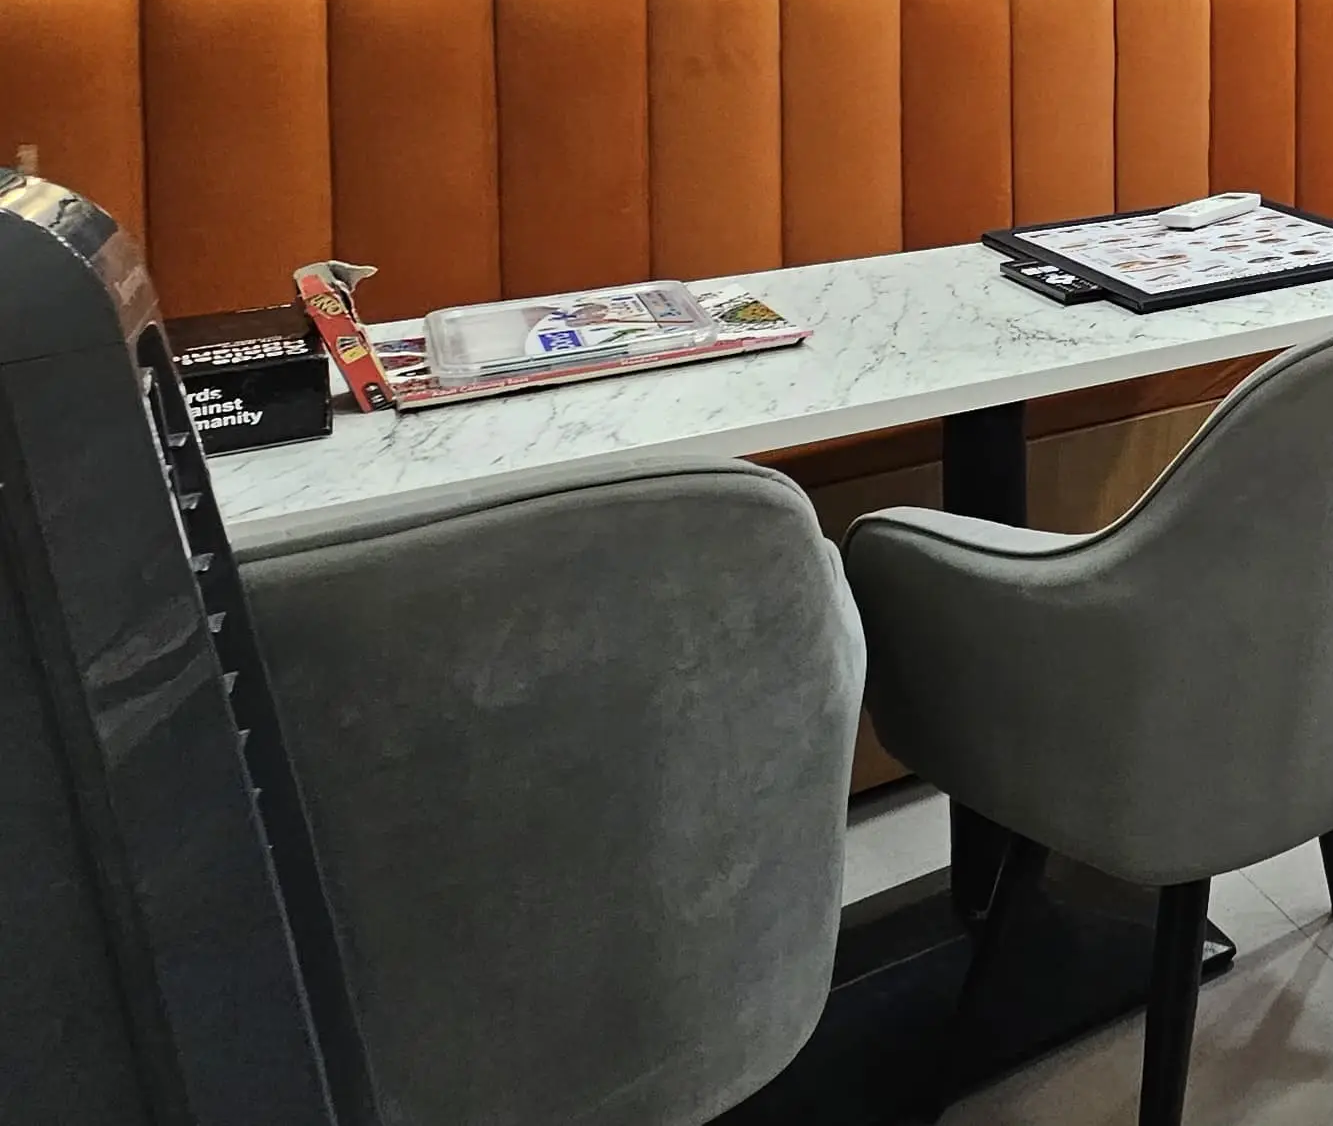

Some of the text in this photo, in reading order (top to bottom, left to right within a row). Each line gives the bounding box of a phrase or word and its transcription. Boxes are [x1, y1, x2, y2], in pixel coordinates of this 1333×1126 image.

[309, 294, 343, 316] UNO
[186, 388, 222, 404] rds
[191, 398, 243, 417] ainst
[195, 411, 263, 431] manity
